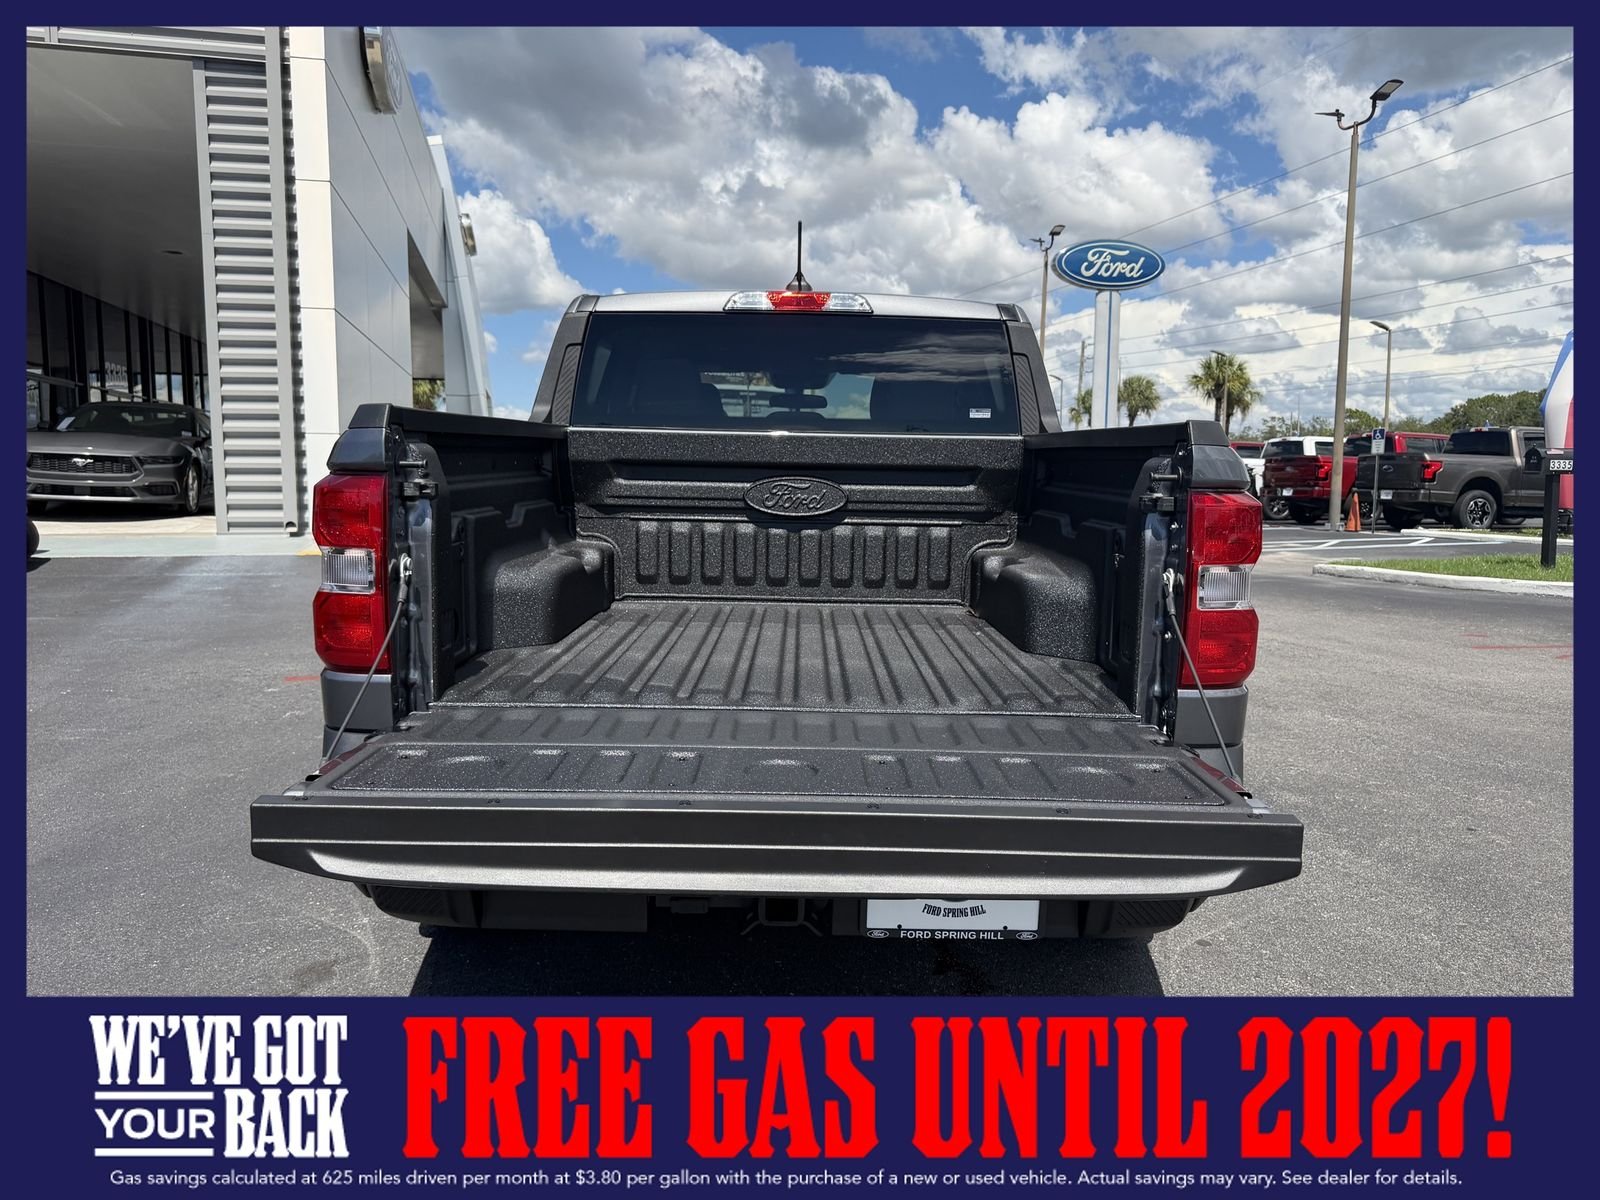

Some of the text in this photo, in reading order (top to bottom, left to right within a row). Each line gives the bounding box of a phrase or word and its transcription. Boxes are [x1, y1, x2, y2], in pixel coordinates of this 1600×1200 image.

[1081, 248, 1145, 278] Ford
[1550, 460, 1573, 470] 3335
[763, 481, 828, 509] Ford
[922, 903, 987, 918] FORD SPRING HILL
[900, 930, 1004, 940] FORD SPRING HILL
